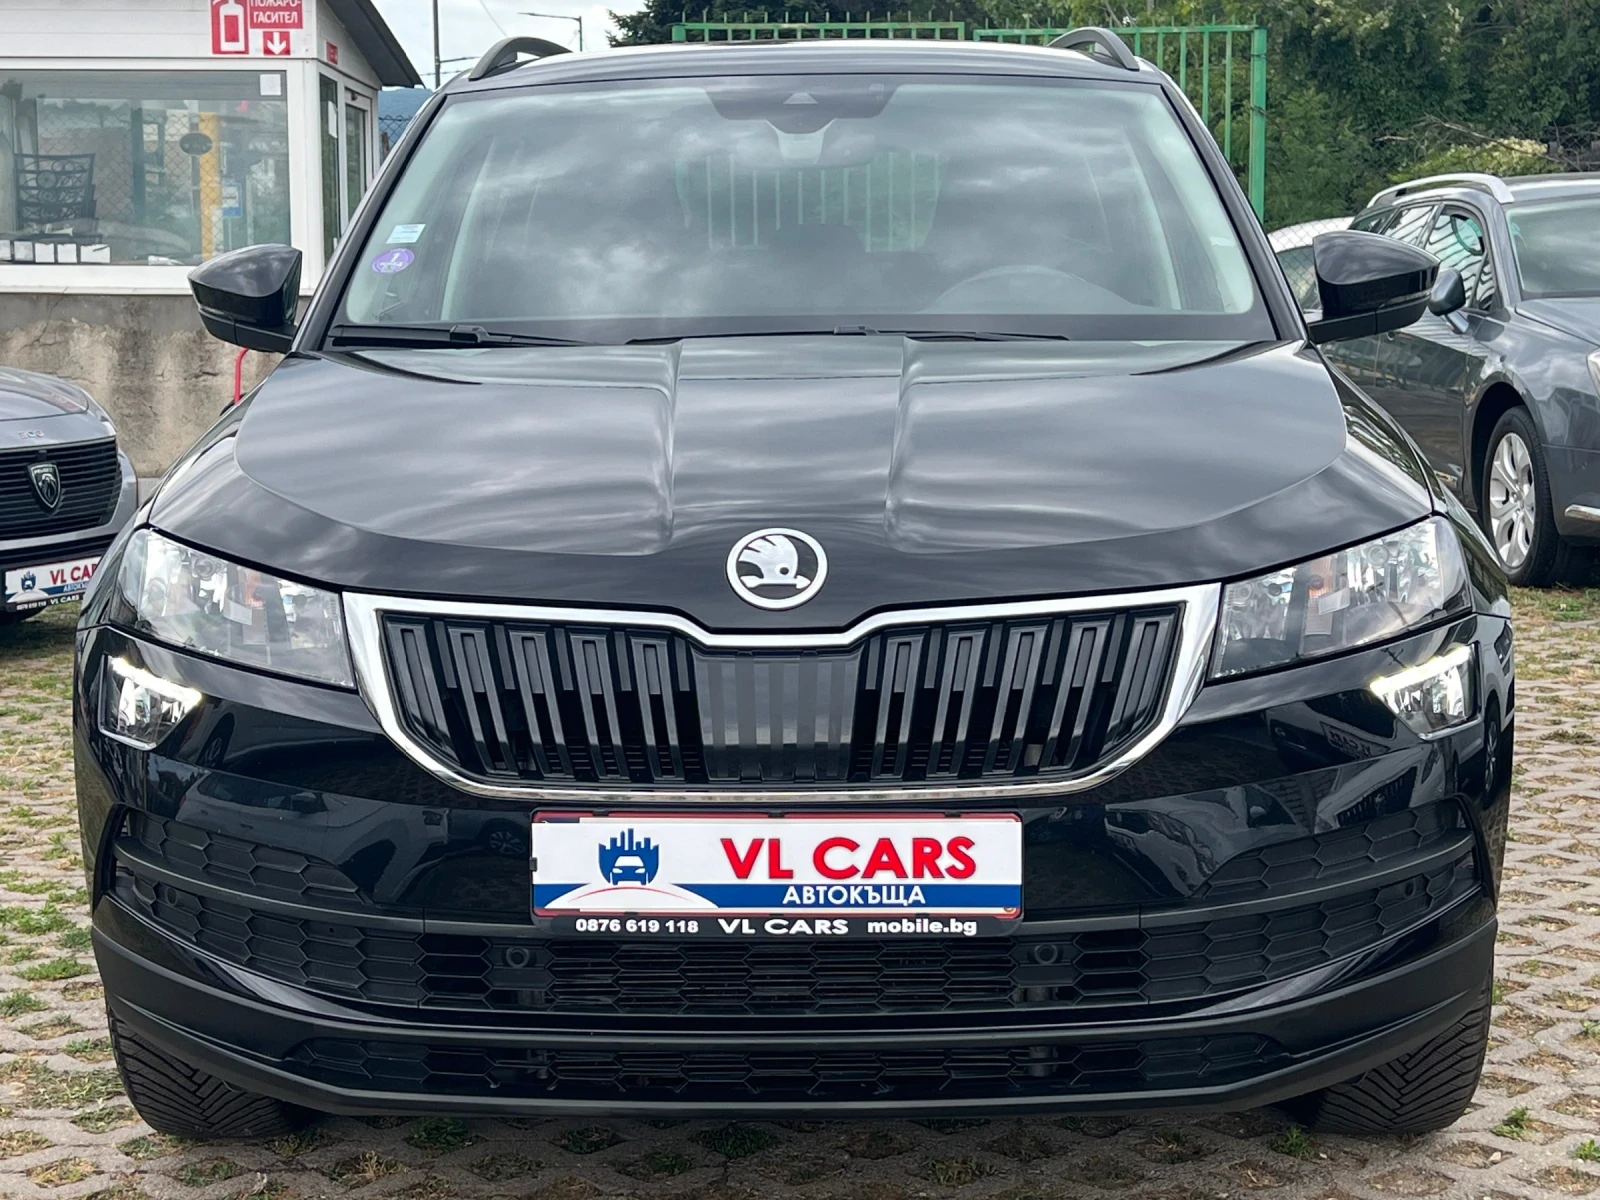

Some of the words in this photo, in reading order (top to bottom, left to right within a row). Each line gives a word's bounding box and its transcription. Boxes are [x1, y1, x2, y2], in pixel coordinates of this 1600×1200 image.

[253, 11, 298, 23] ГАСИТЕЛ
[50, 569, 67, 585] VL
[60, 594, 80, 603] CARS
[720, 837, 794, 879] VL
[812, 836, 977, 880] CARS
[782, 885, 926, 906] АВТОКЪЩА
[575, 918, 621, 933] 0876
[625, 919, 660, 933] 619
[665, 919, 699, 933] 118
[717, 918, 756, 934] VL
[764, 919, 849, 935] CARS
[867, 918, 977, 936] mobile.bg
